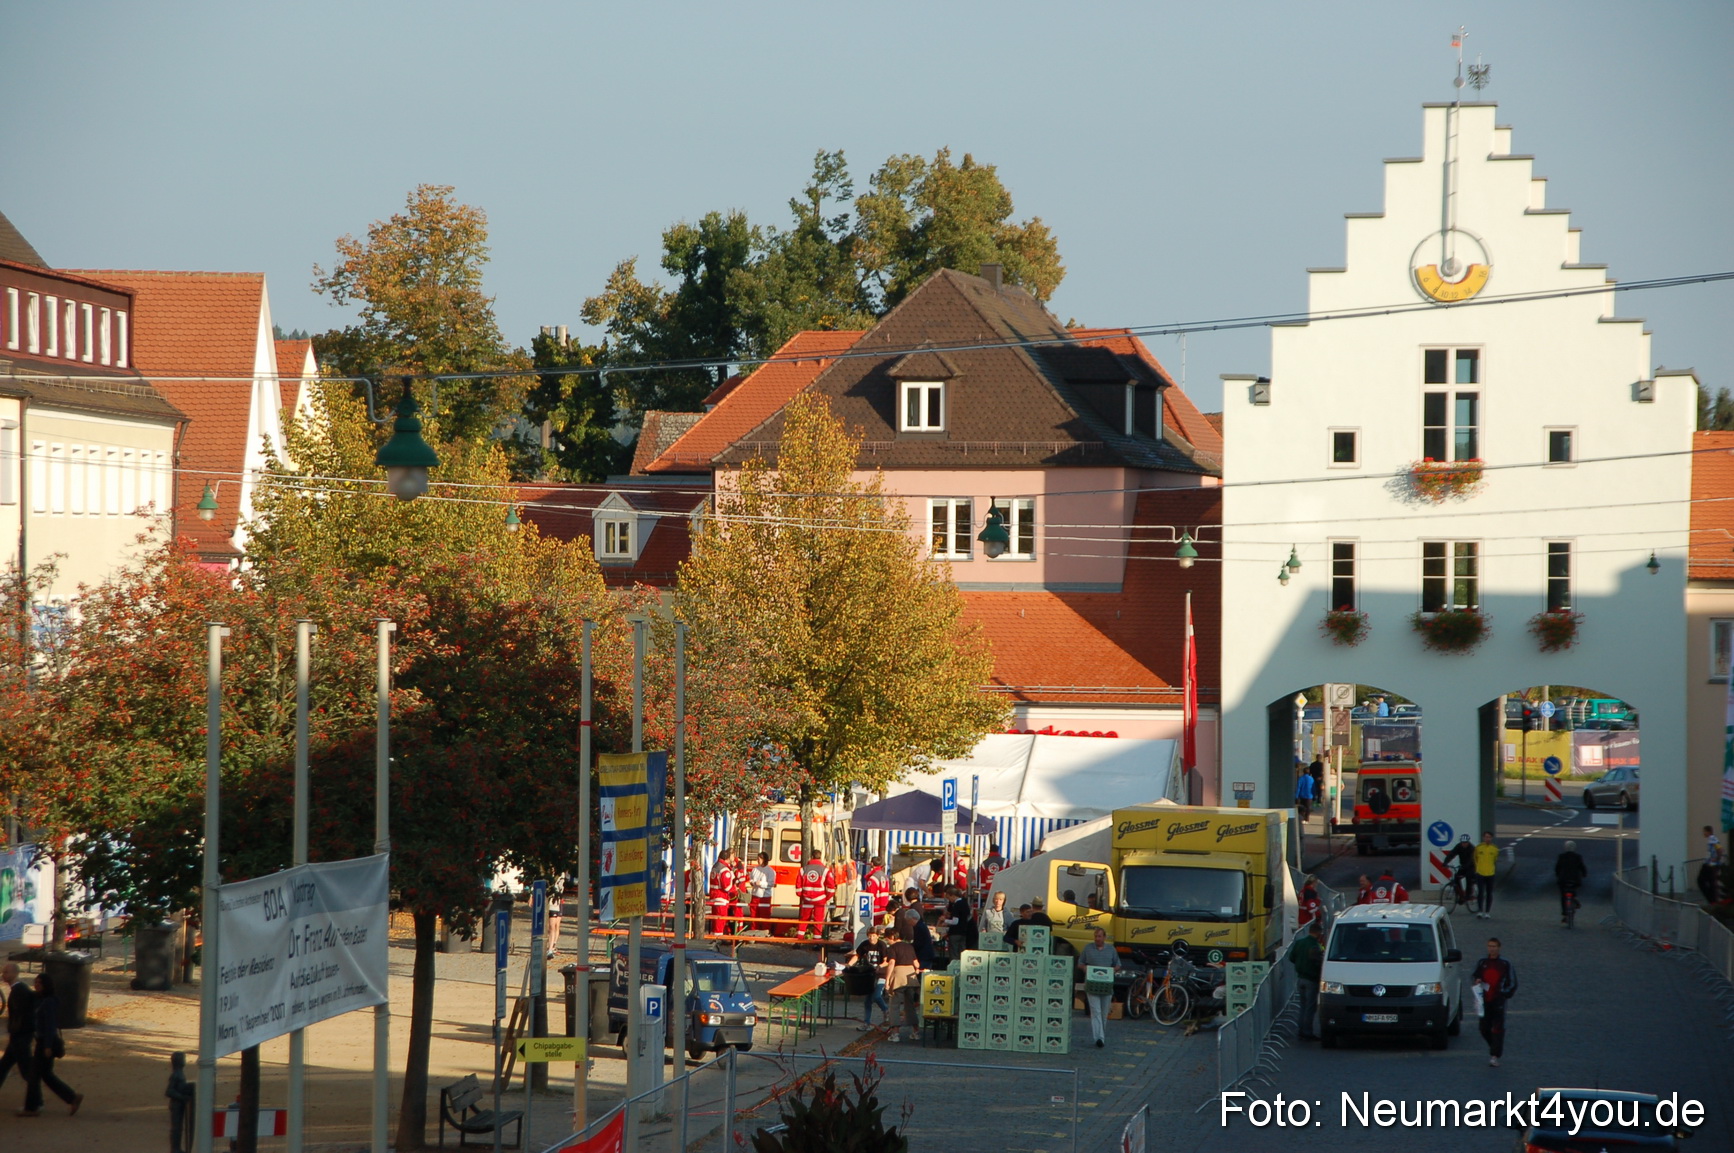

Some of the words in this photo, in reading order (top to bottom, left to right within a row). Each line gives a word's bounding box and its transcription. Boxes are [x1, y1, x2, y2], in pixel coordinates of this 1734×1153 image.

[944, 782, 953, 808] P
[1118, 818, 1161, 840] Glossner
[1167, 820, 1211, 842] Glossner
[1216, 822, 1260, 843] Glossner
[263, 886, 288, 921] BDA
[535, 888, 543, 929] P
[861, 897, 869, 909] P
[1212, 952, 1220, 962] G
[649, 1001, 658, 1015] P
[533, 1042, 574, 1051] Chipabgabe-
